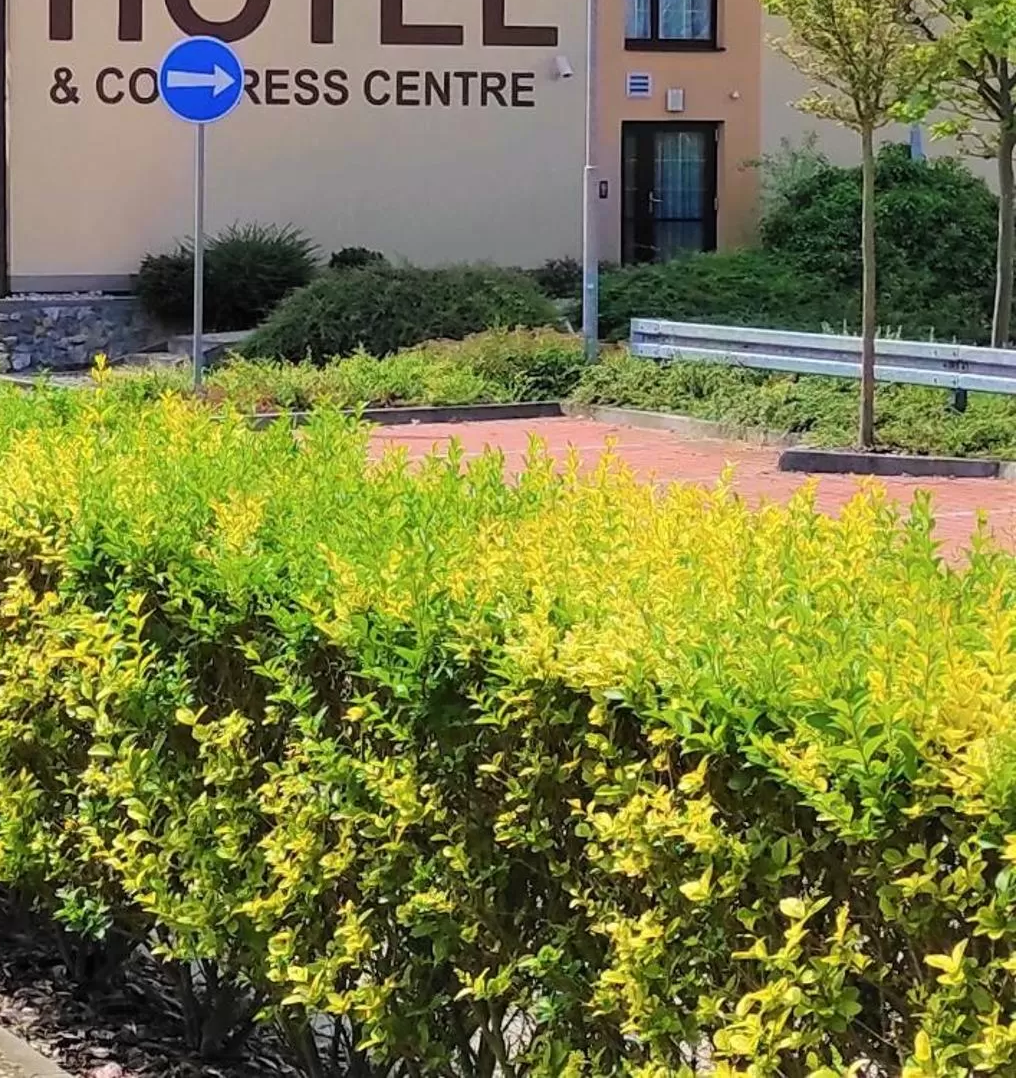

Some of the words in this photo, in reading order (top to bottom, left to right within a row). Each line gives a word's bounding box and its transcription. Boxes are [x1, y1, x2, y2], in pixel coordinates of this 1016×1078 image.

[49, 66, 80, 105] &
[95, 66, 349, 106] CORESS
[363, 69, 535, 108] CENTRE
